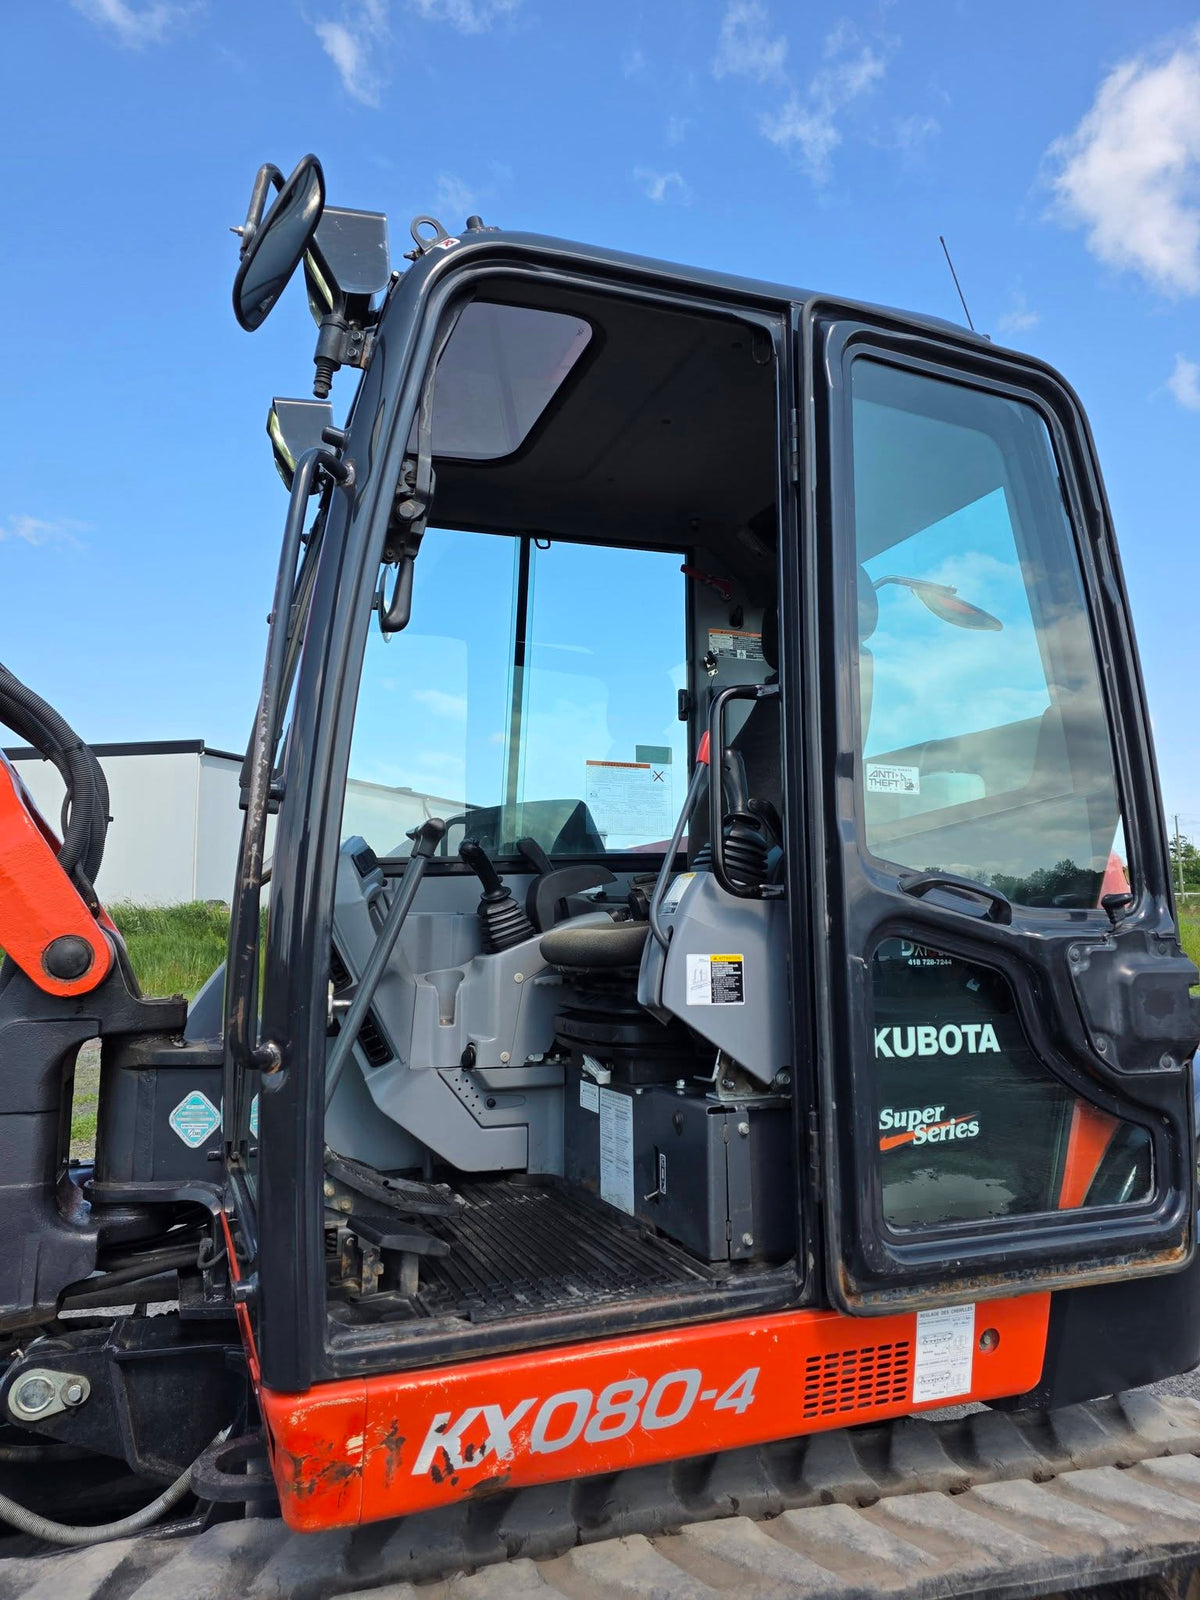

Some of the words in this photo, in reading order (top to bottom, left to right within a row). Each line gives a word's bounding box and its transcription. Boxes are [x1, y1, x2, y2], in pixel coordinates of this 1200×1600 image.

[869, 770, 895, 779] ANTI
[869, 778, 900, 788] THEFT
[874, 1024, 1001, 1058] KUBOTA
[879, 1106, 945, 1132] Super
[913, 1118, 979, 1145] Series
[411, 1367, 760, 1475] KX080-4
